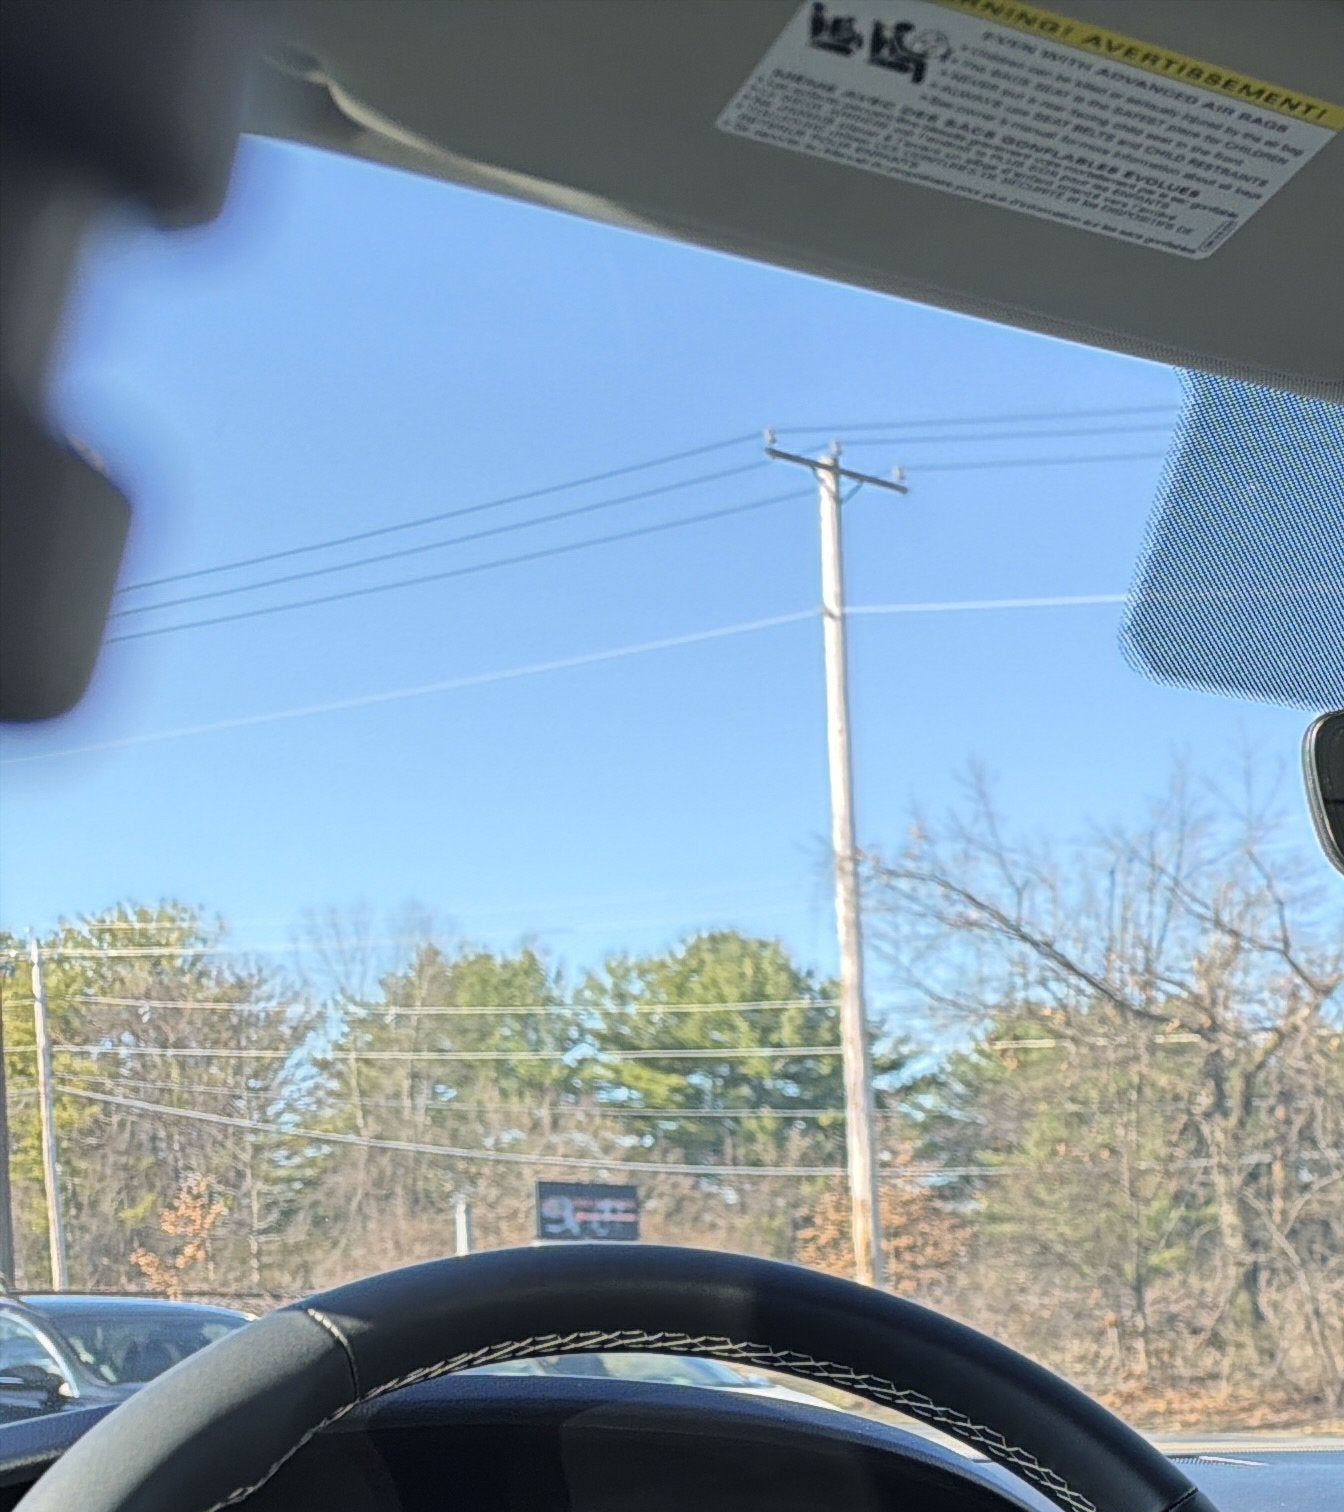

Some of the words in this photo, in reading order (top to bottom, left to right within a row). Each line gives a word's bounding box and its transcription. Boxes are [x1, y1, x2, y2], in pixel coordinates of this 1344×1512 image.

[1079, 33, 1329, 121] AVERTISSEMENT!
[1092, 67, 1203, 105] ADVANCED
[1199, 101, 1236, 116] AIR
[1235, 111, 1292, 133] BAGS
